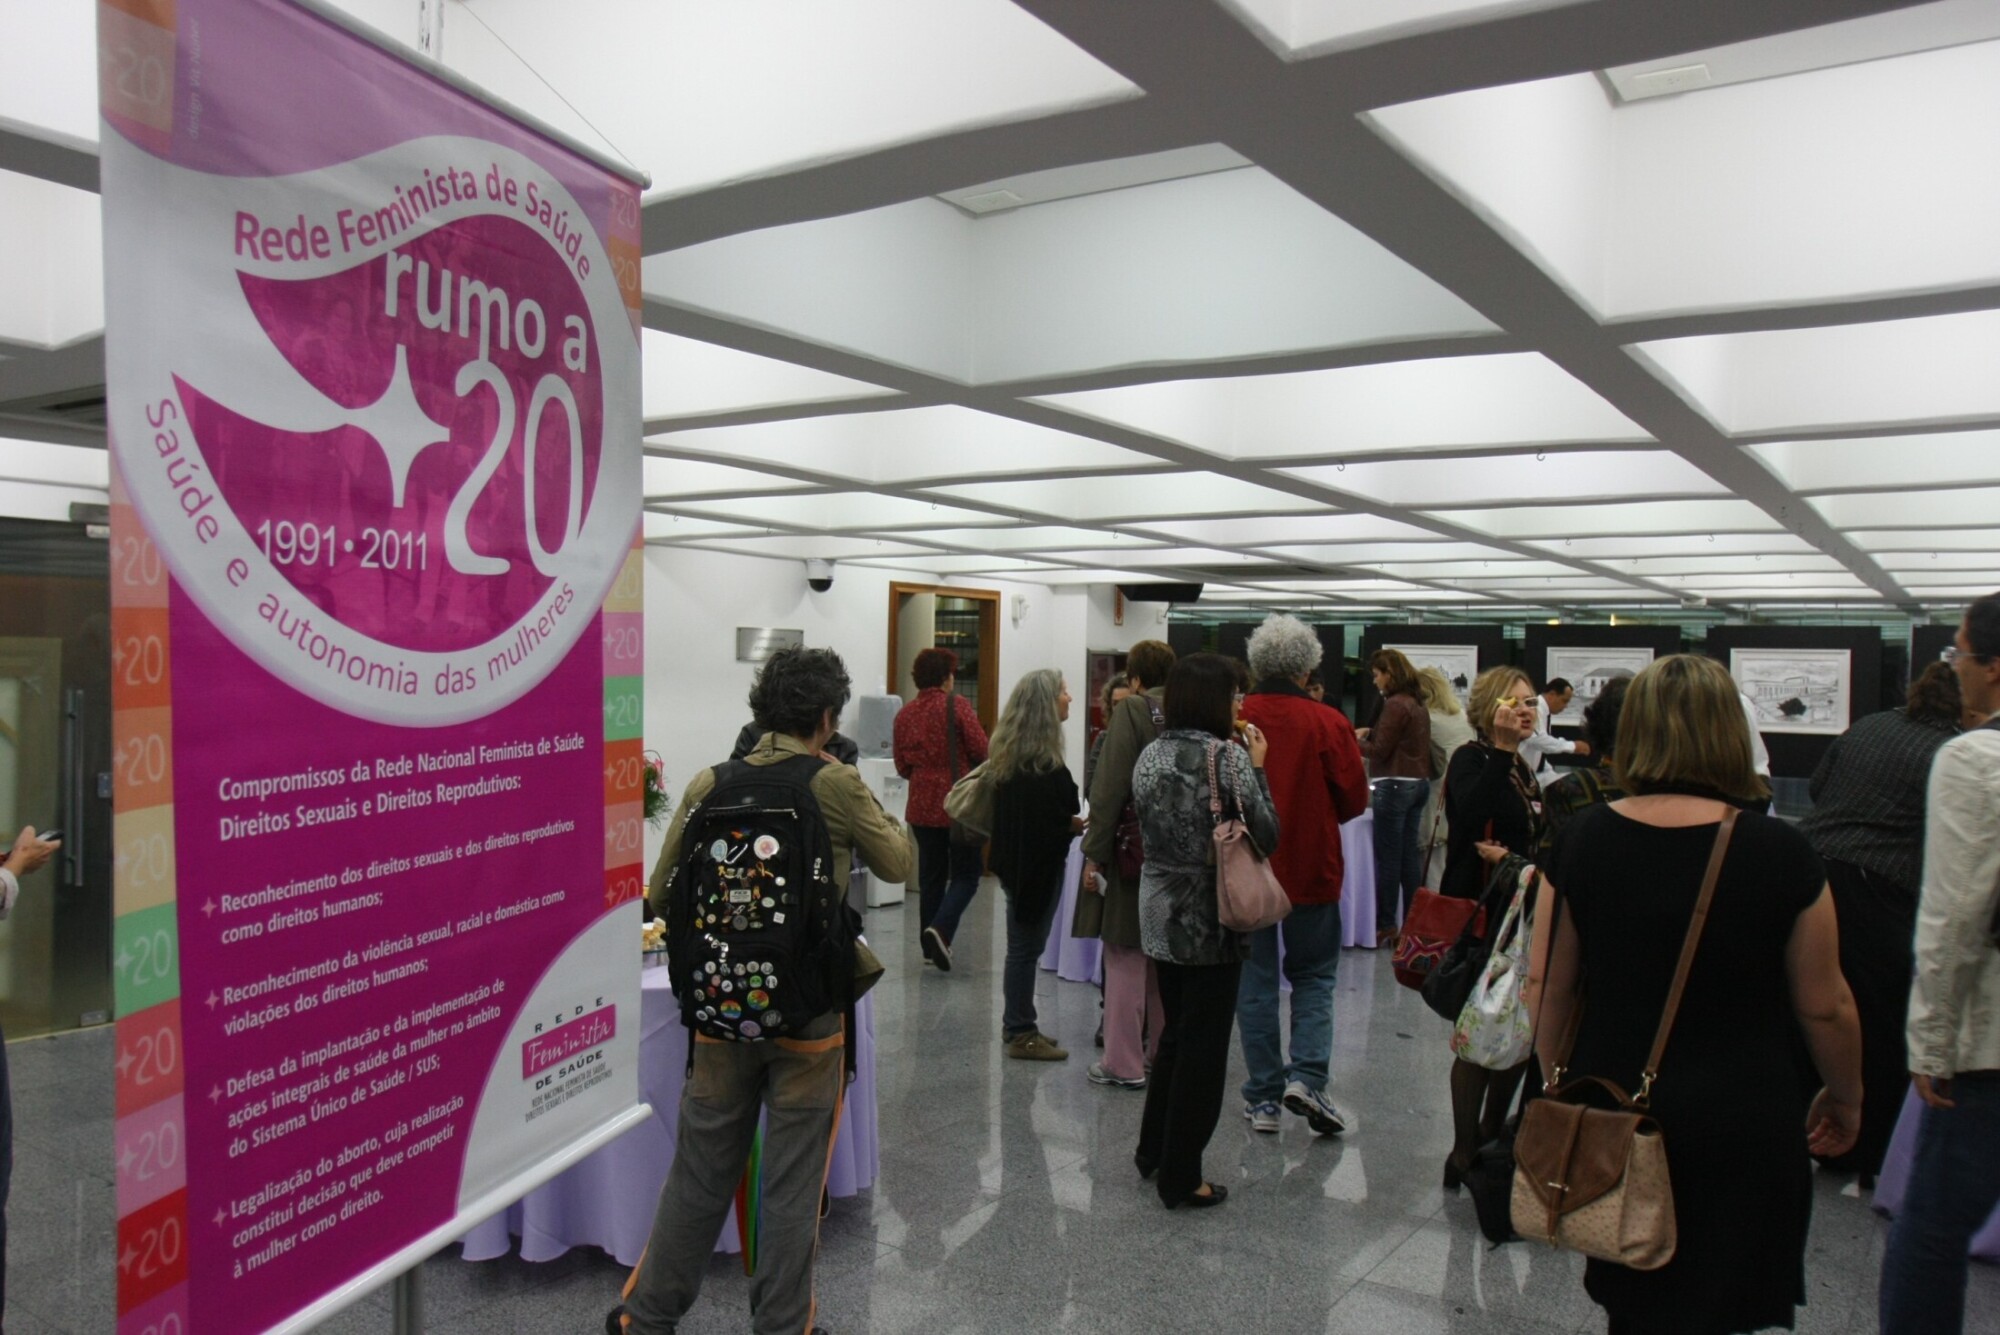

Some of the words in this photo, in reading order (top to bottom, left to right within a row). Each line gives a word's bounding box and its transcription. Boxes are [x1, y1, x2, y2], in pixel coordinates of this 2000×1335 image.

[235, 210, 330, 262] Rede
[339, 164, 478, 253] Feminista
[485, 163, 518, 207] de
[525, 182, 590, 281] Saúde
[385, 250, 546, 360] rumo
[563, 315, 587, 373] a
[445, 360, 583, 578] 20
[146, 398, 221, 545] Saúde
[226, 556, 250, 587] e
[258, 592, 419, 696] autonomia
[434, 663, 477, 697] das
[486, 581, 575, 682] mulheres
[219, 765, 346, 802] Compromissos
[351, 760, 371, 782] da
[375, 757, 413, 779] Rede
[417, 747, 476, 773] Nacional
[479, 740, 535, 764] Feminista
[537, 737, 551, 755] de
[554, 732, 584, 753] Saúde
[220, 812, 290, 841] Direitos
[296, 798, 357, 828] Sexuais
[362, 800, 372, 816] e
[377, 788, 432, 814] Direitos
[436, 773, 522, 806] Reprodutivos:
[221, 873, 337, 914] Reconhecimento
[341, 866, 363, 886] dos
[366, 856, 411, 879] direitos
[413, 845, 453, 869] sexuais
[456, 844, 463, 858] e
[465, 838, 482, 856] dos
[485, 830, 520, 852] direitos
[522, 819, 575, 845] reprodutivos
[221, 922, 263, 945] como
[267, 905, 319, 933] direitos
[322, 891, 383, 919] humanos;
[223, 960, 339, 1006] Reconhecimento
[342, 950, 359, 967] da
[361, 935, 413, 961] violência
[416, 922, 454, 946] sexual,
[456, 911, 483, 933] racial
[485, 911, 492, 925] e
[494, 897, 540, 922] doméstica
[541, 888, 565, 905] como
[224, 1004, 290, 1037] violações
[294, 993, 318, 1013] dos
[322, 976, 370, 1004] direitos
[373, 958, 429, 987] humanos;
[226, 1064, 275, 1098] Defesa
[279, 1056, 297, 1077] da
[301, 1029, 380, 1069] implantação
[383, 1023, 391, 1037] e
[394, 1015, 409, 1032] da
[411, 987, 490, 1028] implementação
[492, 978, 505, 993] de
[227, 1098, 268, 1129] ações
[271, 1072, 331, 1110] integrais
[333, 1063, 350, 1084] de
[353, 1051, 389, 1077] saúde
[392, 1041, 407, 1060] da
[409, 1028, 448, 1053] mulher
[450, 1021, 464, 1036] no
[466, 1005, 501, 1029] âmbito
[528, 1016, 611, 1072] Feminista
[535, 997, 603, 1033] REDE
[228, 1135, 248, 1158] do
[252, 1112, 307, 1148] Sistema
[310, 1095, 348, 1122] Único
[351, 1085, 367, 1105] de
[370, 1069, 406, 1097] Saúde
[408, 1064, 413, 1083] /
[416, 1054, 441, 1077] SUS;
[535, 1075, 552, 1091] DE
[558, 1050, 603, 1079] SAÚDE
[231, 1168, 312, 1219] Legalização
[316, 1157, 333, 1178] do
[336, 1137, 381, 1168] aborto,
[384, 1120, 408, 1144] cuja
[411, 1095, 464, 1131] realização
[232, 1201, 294, 1248] constitui
[297, 1181, 346, 1215] decisão
[349, 1168, 373, 1192] que
[376, 1152, 404, 1175] deve
[407, 1123, 455, 1159] competir
[233, 1259, 243, 1279] à
[246, 1233, 297, 1272] mulher
[301, 1217, 337, 1243] como
[340, 1189, 384, 1221] direito.
